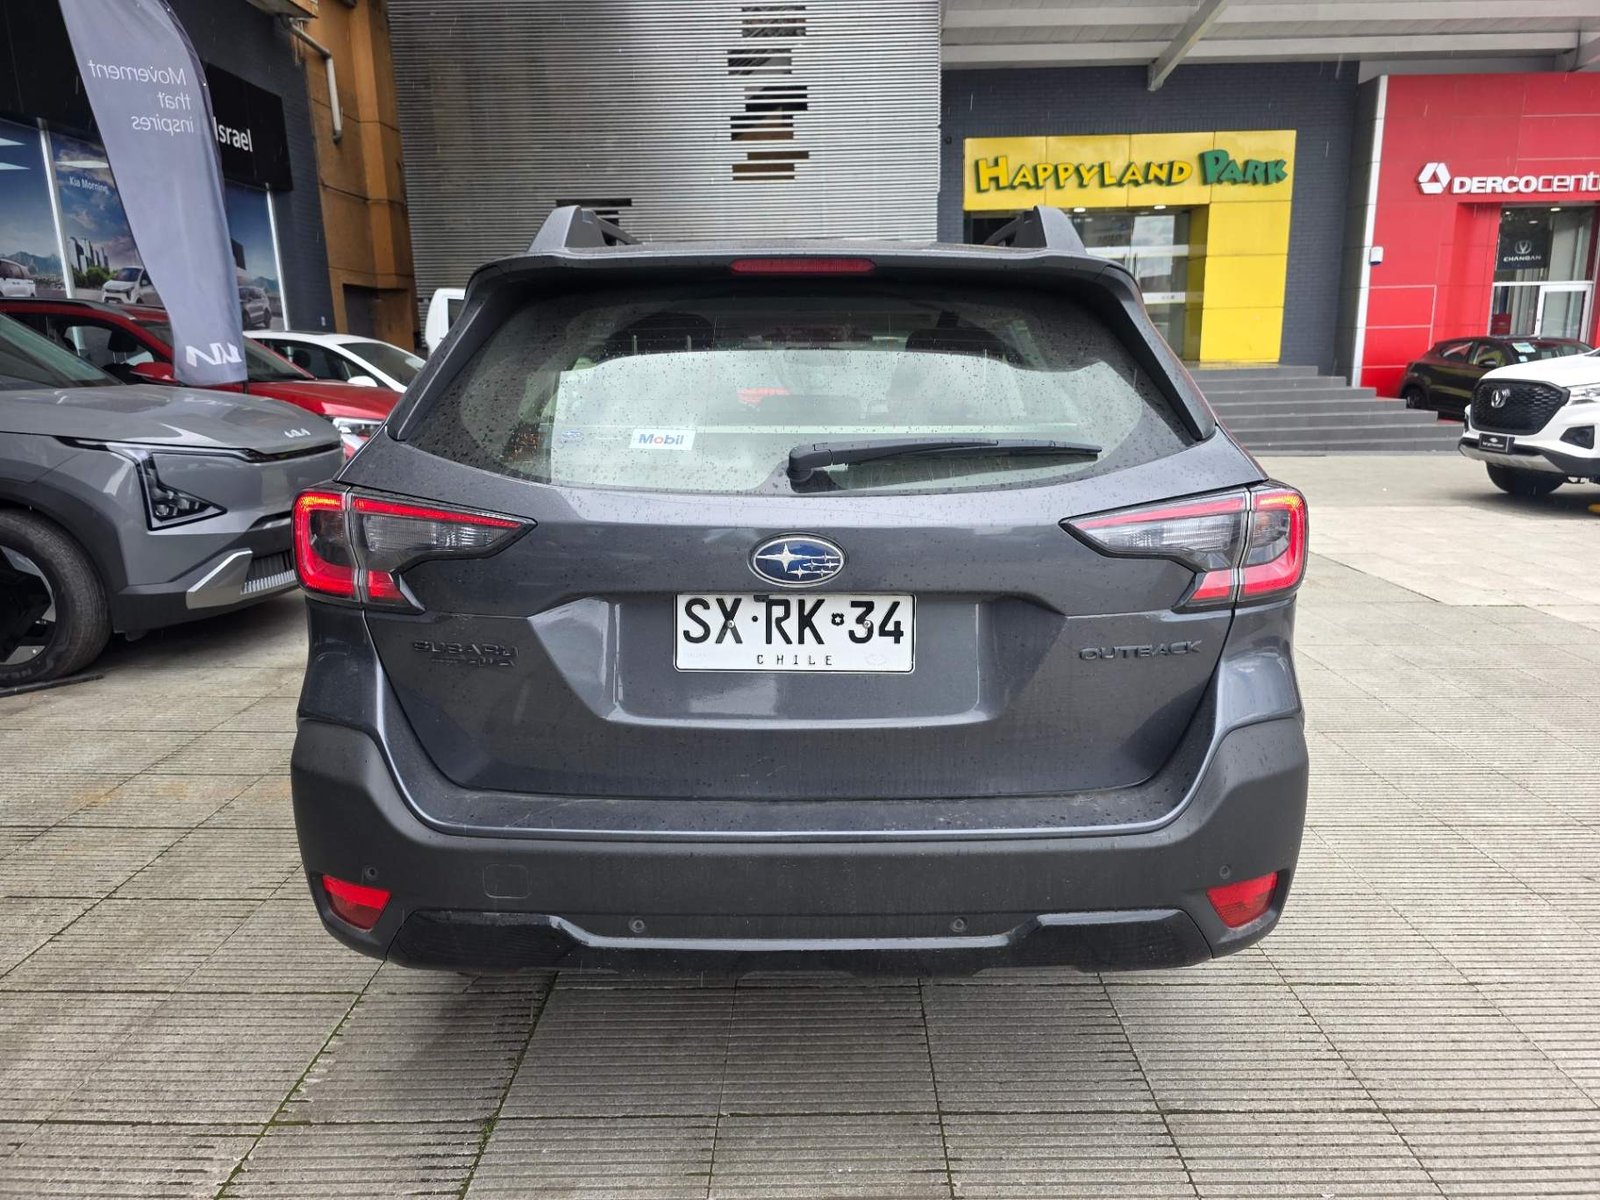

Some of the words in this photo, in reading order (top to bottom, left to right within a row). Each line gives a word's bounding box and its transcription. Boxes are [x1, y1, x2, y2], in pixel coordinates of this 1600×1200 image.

[212, 116, 253, 152] Israel
[975, 154, 1194, 193] HAPPYLAND
[1199, 149, 1288, 186] PARK
[1452, 171, 1600, 194] DERCOcent
[639, 433, 684, 445] Mobil
[756, 654, 832, 666] CHILE
[1080, 640, 1202, 659] OUTBACK
